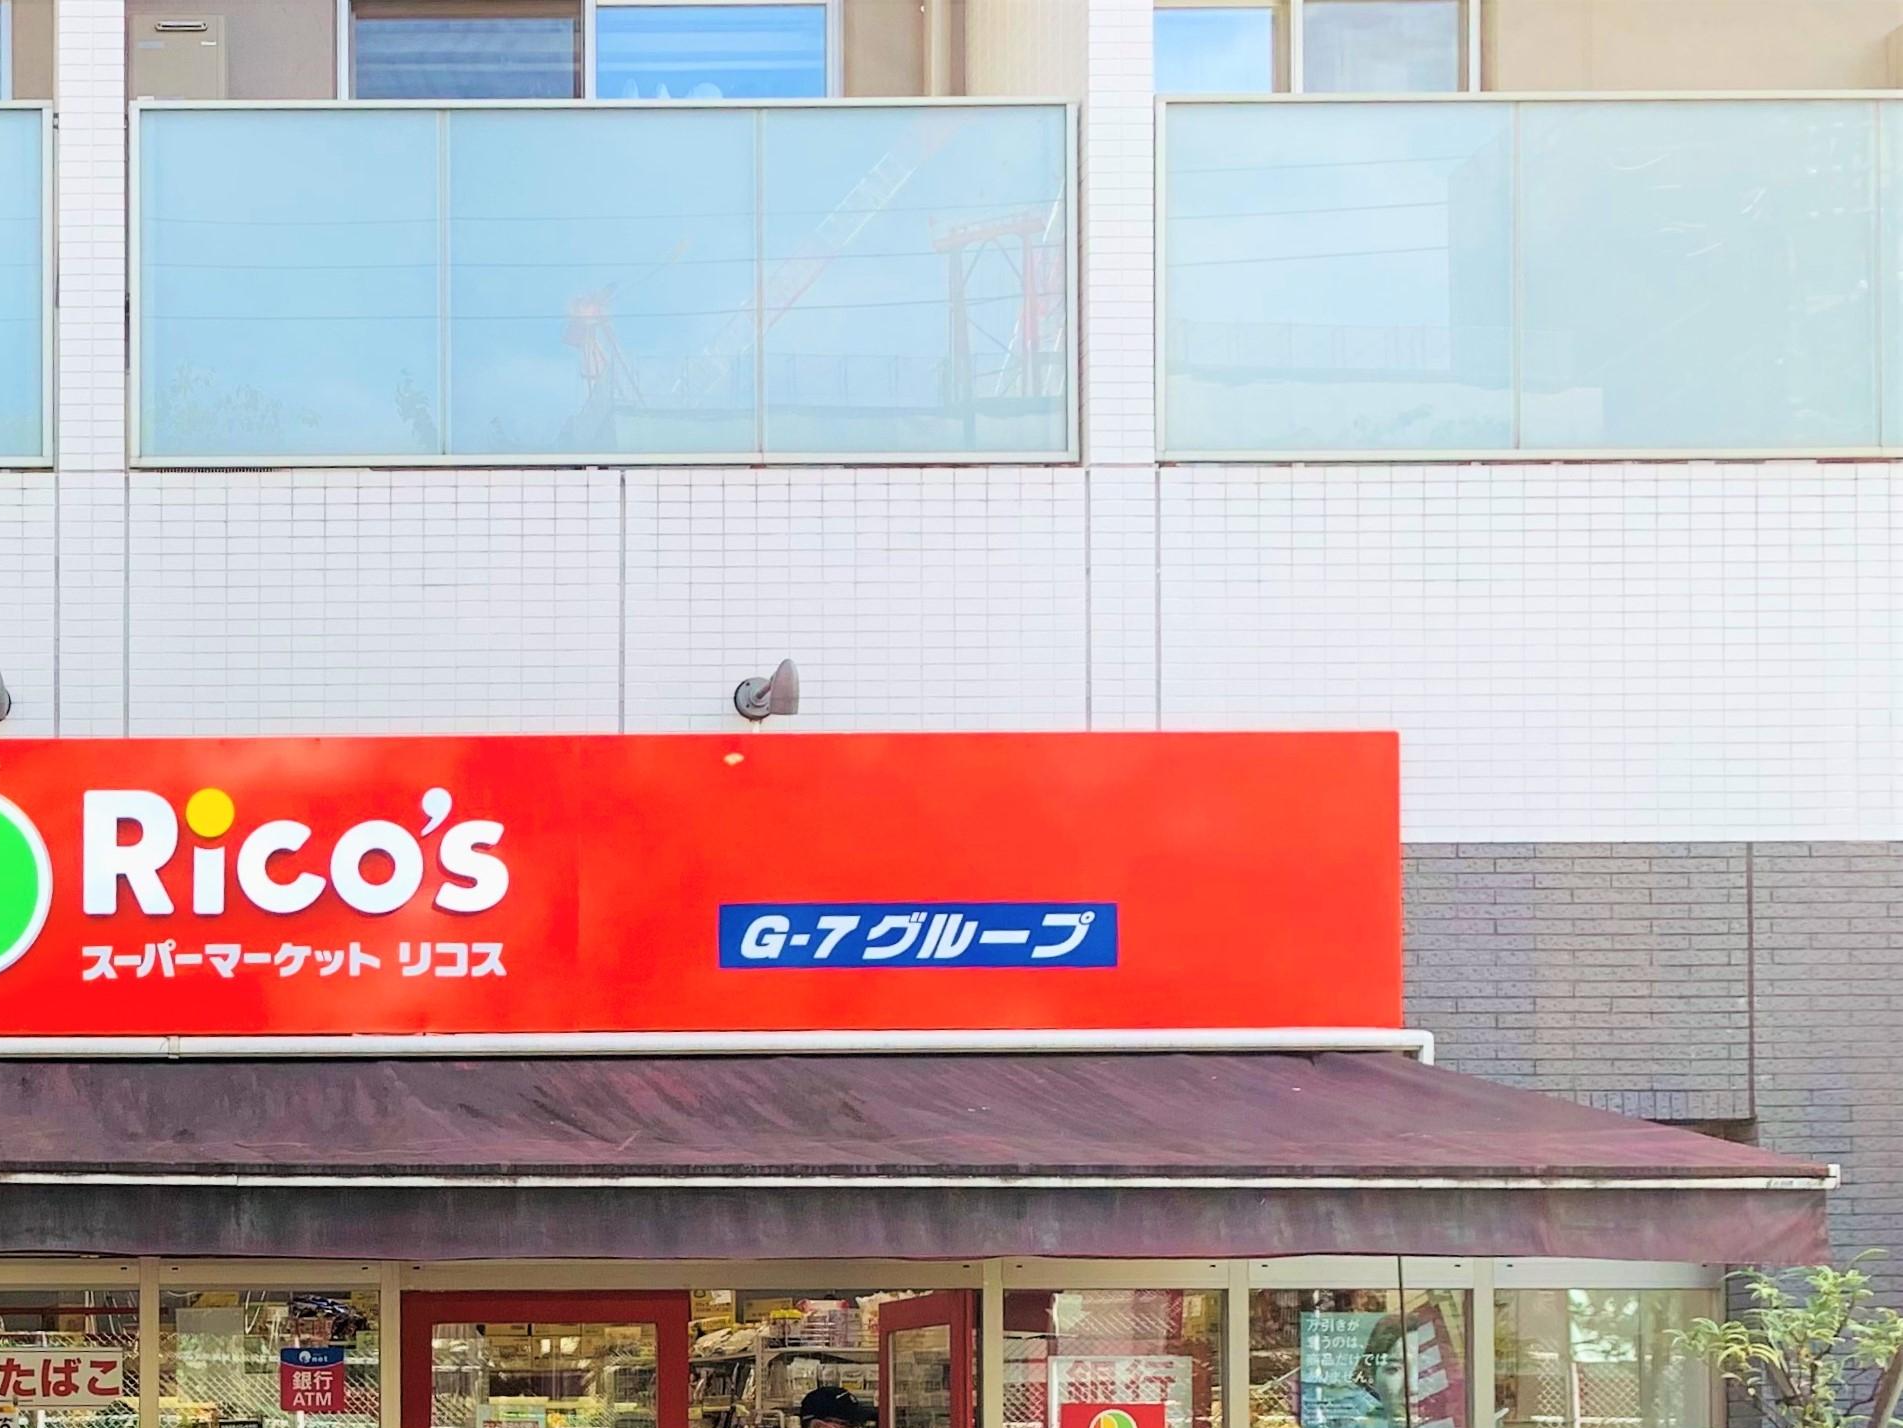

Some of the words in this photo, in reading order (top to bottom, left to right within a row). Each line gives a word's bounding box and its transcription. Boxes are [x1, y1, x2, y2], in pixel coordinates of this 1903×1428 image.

[83, 788, 509, 915] Rico's
[82, 940, 381, 980] スーパーマーケット
[399, 942, 507, 979] リコス
[292, 1371, 333, 1390] 銀行
[293, 1392, 332, 1406] ATM
